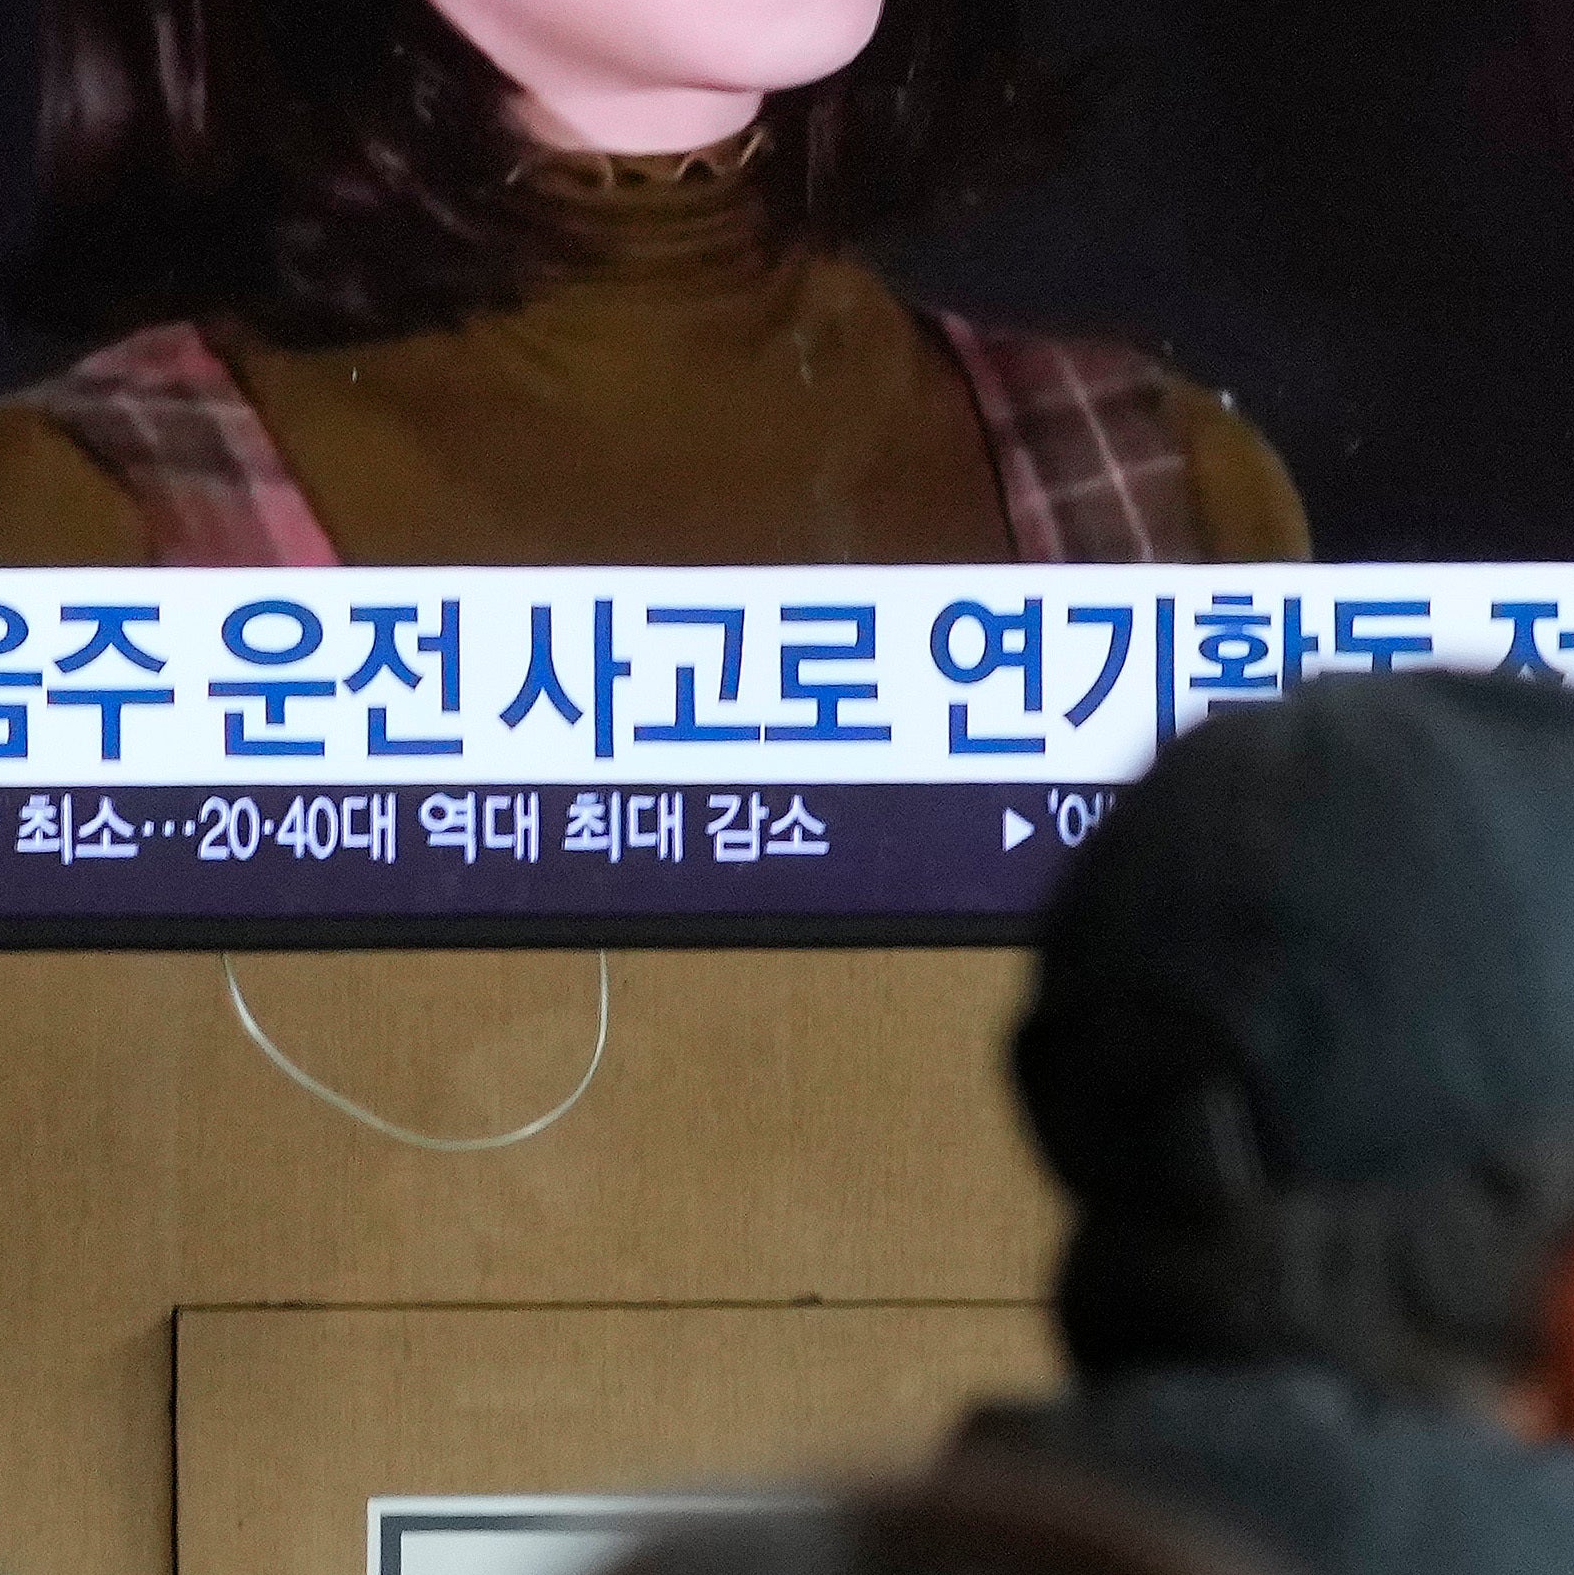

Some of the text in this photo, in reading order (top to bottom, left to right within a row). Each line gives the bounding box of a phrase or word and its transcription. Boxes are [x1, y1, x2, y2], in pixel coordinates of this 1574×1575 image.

[208, 599, 464, 757] 운전
[499, 599, 892, 759] 사고로
[420, 791, 540, 865] 역대
[563, 791, 684, 864] 최대
[706, 791, 830, 863] 감소
